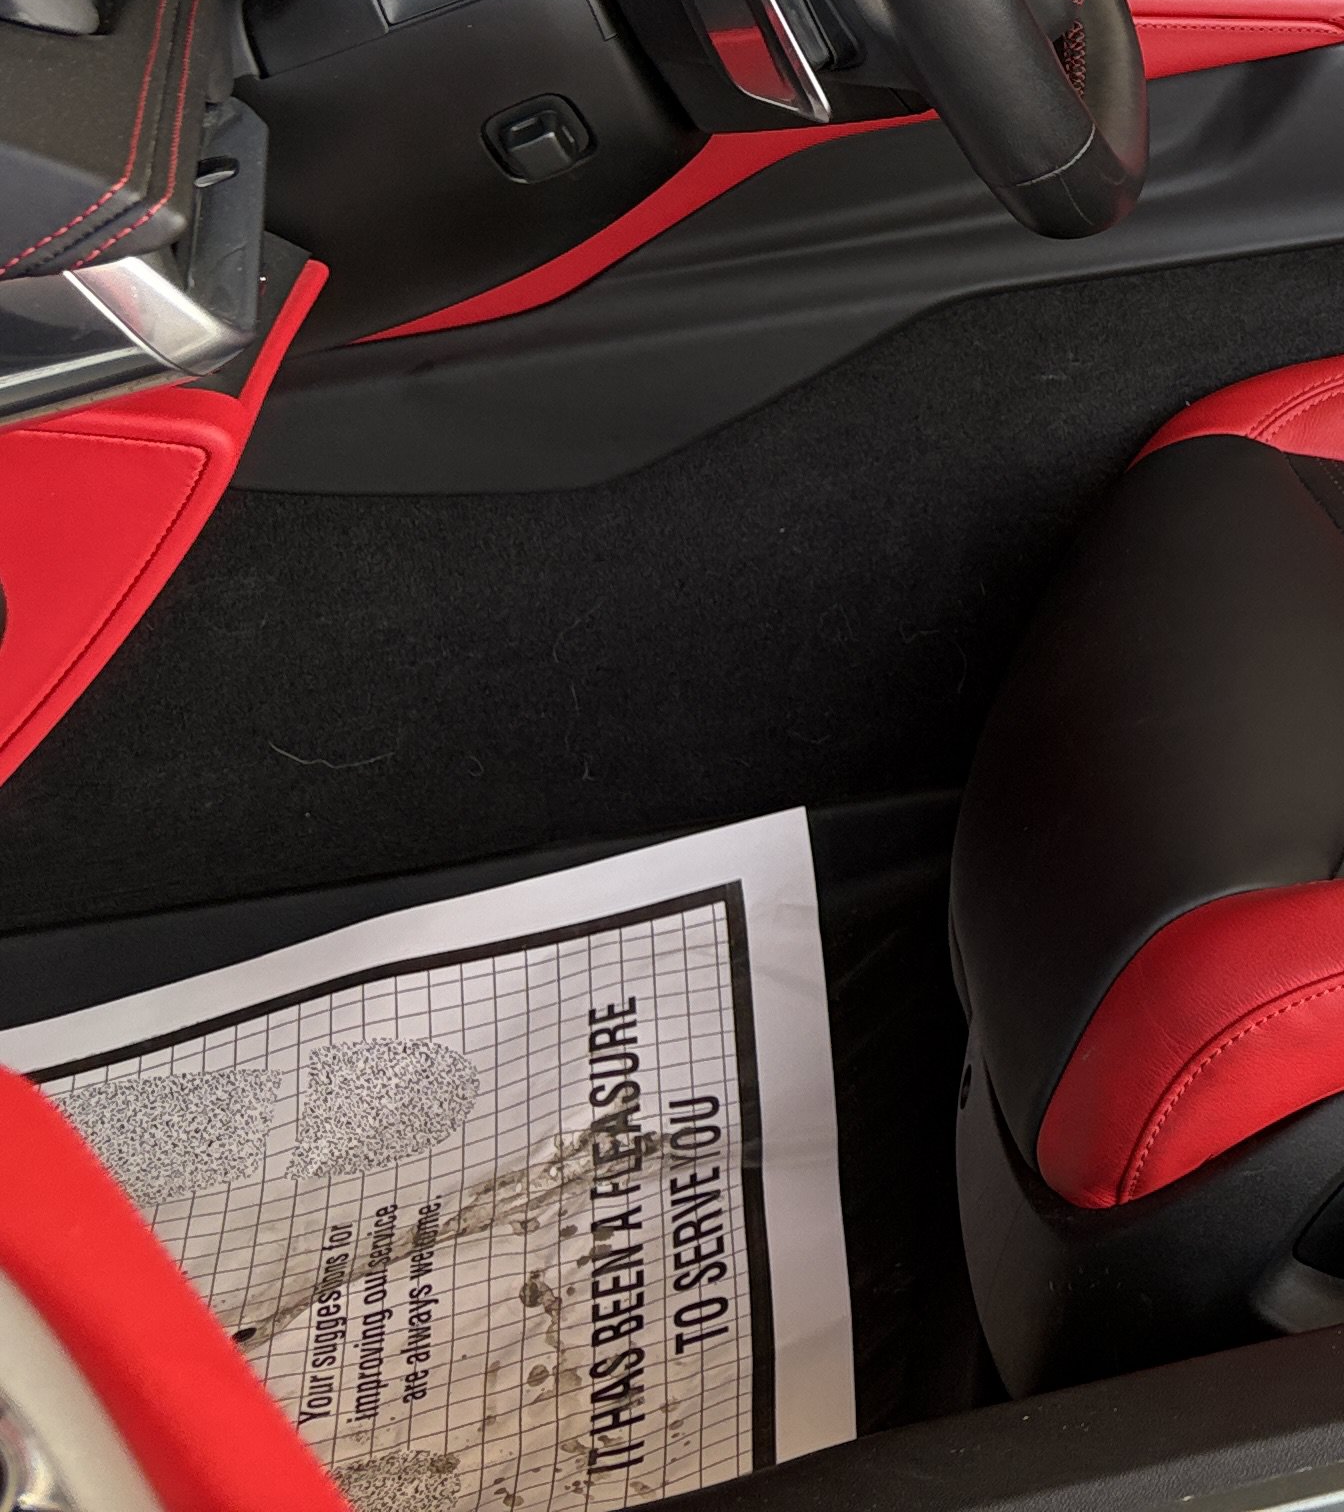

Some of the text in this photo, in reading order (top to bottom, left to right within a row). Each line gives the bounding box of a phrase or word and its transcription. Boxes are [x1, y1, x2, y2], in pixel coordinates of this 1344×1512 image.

[590, 1243, 644, 1347] BEEN
[591, 1204, 643, 1235] A
[669, 1095, 729, 1355] TO SERVE YOU
[298, 1221, 353, 1426] Your suggestions for
[346, 1204, 398, 1423] improving our service
[400, 1195, 443, 1404] are always welcome.
[587, 1440, 645, 1476] IT
[589, 1347, 645, 1436] HAS
